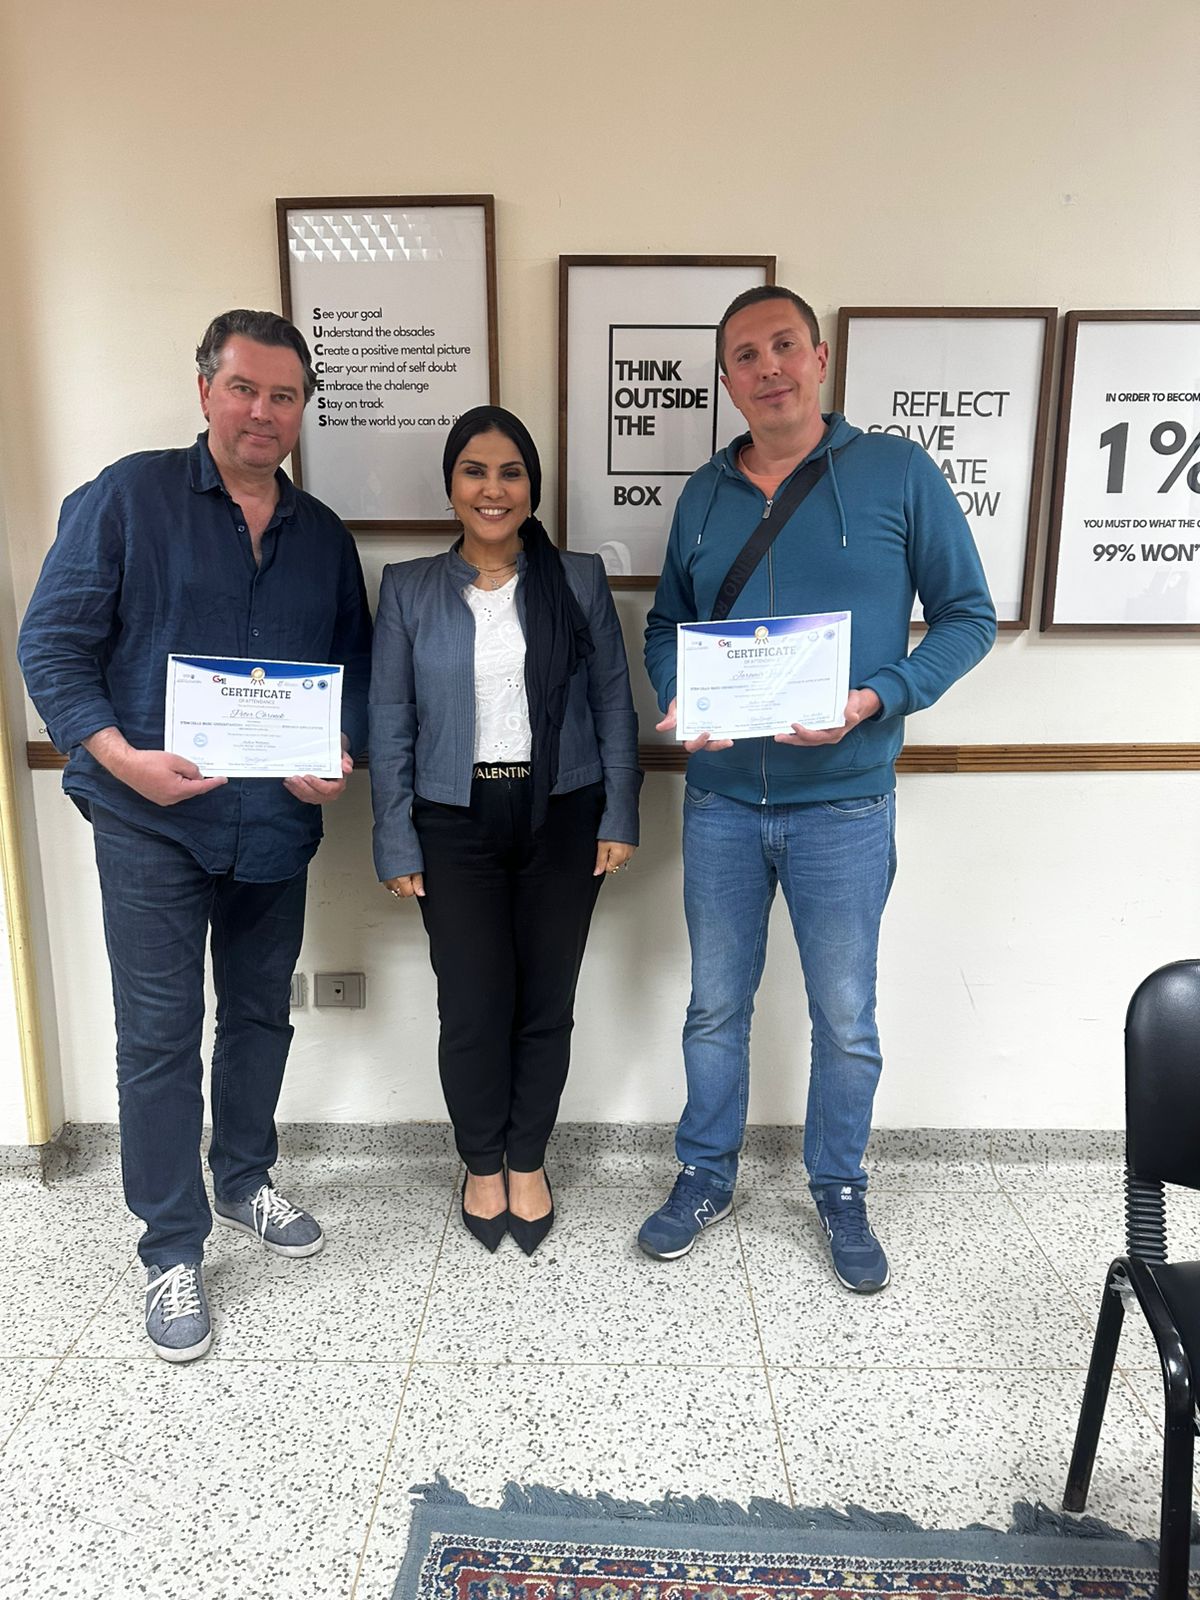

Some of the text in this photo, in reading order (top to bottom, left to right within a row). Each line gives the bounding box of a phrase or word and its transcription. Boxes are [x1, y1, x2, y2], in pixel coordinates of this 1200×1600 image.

[313, 307, 383, 321] See your goal
[313, 326, 373, 338] Understand
[375, 326, 391, 337] the
[314, 344, 350, 355] Create
[361, 344, 399, 358] positive
[401, 344, 434, 355] mental
[437, 344, 471, 357] picture
[315, 361, 457, 375] Clear your mind of self doubt
[615, 360, 682, 381] THINK
[317, 380, 363, 391] Embrace
[365, 380, 382, 390] the
[317, 397, 342, 411] Stay
[360, 398, 384, 408] track
[615, 388, 708, 409] OUTSIDE
[892, 391, 1010, 417] REFLECT
[1105, 393, 1117, 402] IN
[1118, 393, 1150, 402] ORDER
[1152, 393, 1165, 402] TO
[319, 415, 348, 426] Show
[350, 415, 367, 426] the
[369, 415, 396, 426] world
[397, 419, 415, 428] you
[438, 415, 450, 425] do
[614, 415, 656, 436] THE
[614, 486, 662, 506] BOX
[1083, 519, 1104, 528] YOU
[1104, 519, 1132, 528] MUST
[1132, 519, 1147, 528] DO
[1148, 519, 1177, 528] WHAT
[1178, 519, 1195, 528] THE
[1092, 543, 1137, 562] 99%
[727, 646, 797, 660] CERTIFICATE
[220, 686, 292, 700] CERTIFICATE
